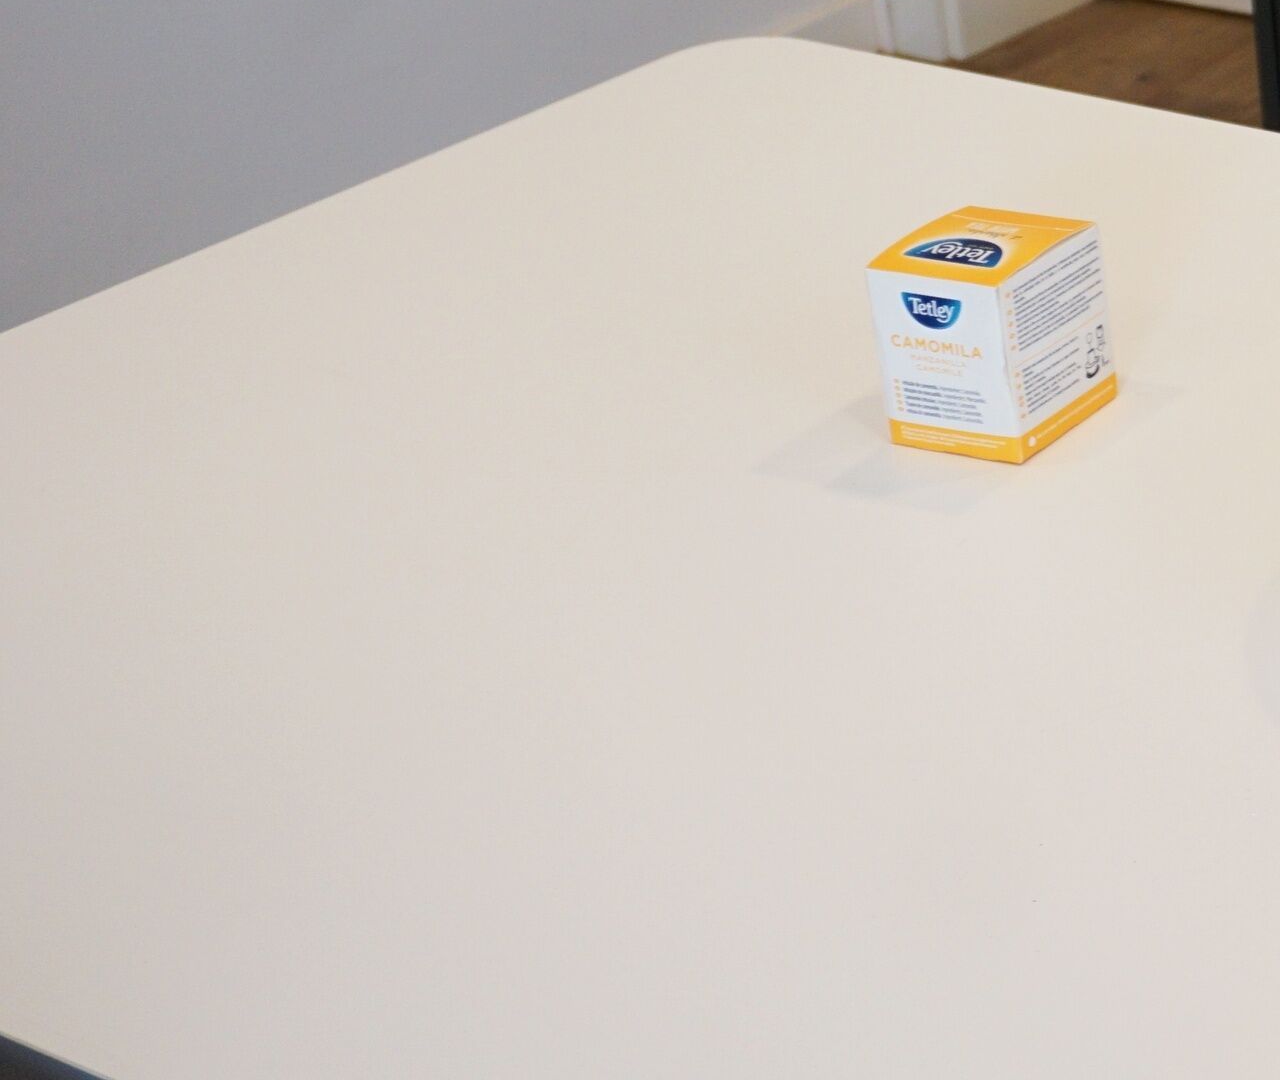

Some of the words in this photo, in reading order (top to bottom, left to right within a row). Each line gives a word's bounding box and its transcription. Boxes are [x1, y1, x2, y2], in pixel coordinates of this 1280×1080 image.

[921, 241, 995, 264] Tetley
[908, 296, 955, 324] Tetley
[890, 334, 984, 360] CAMOMILA
